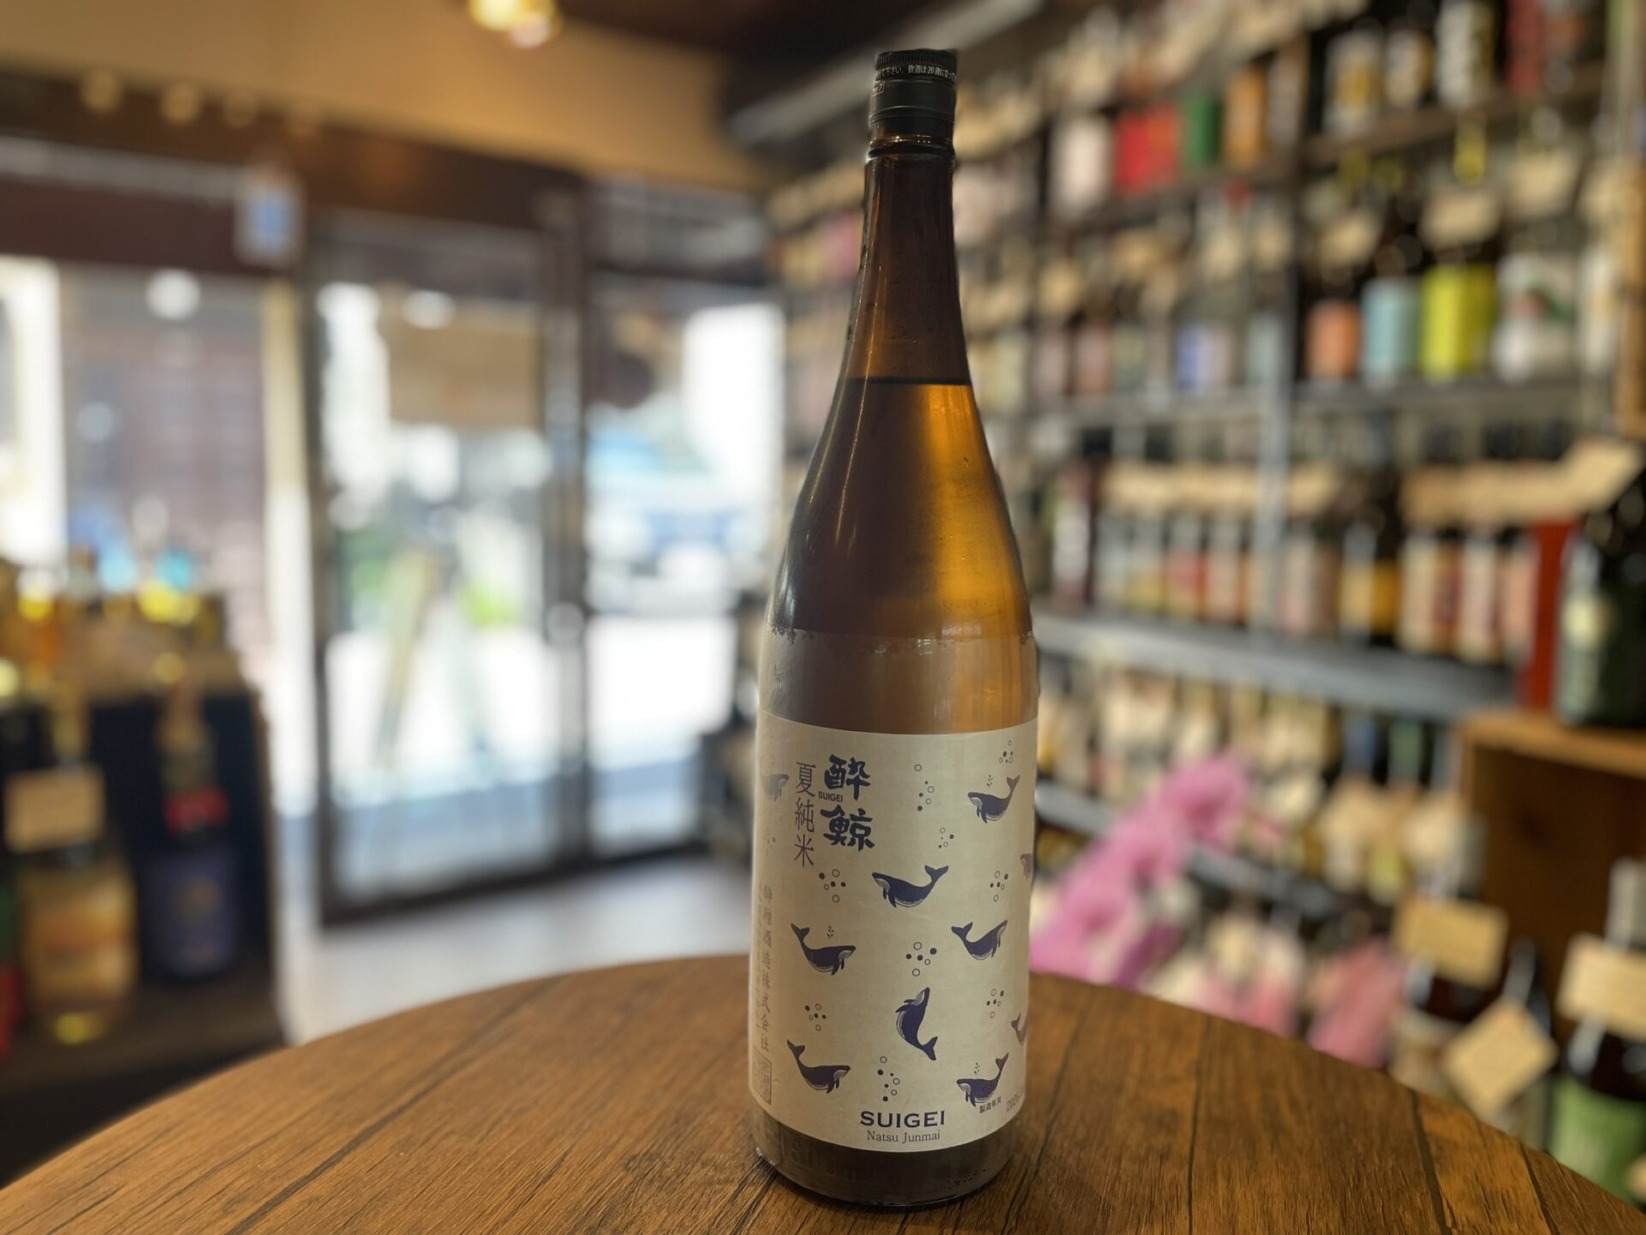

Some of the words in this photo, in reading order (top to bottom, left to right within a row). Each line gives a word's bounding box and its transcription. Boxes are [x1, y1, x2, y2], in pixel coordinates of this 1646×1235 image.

[818, 790, 843, 803] SUIGEI
[820, 754, 875, 851] 酔鯨
[794, 761, 816, 868] 夏純米
[859, 1110, 946, 1129] SUIGEI
[866, 1130, 899, 1143] Natsu
[901, 1129, 942, 1144] Junmai
